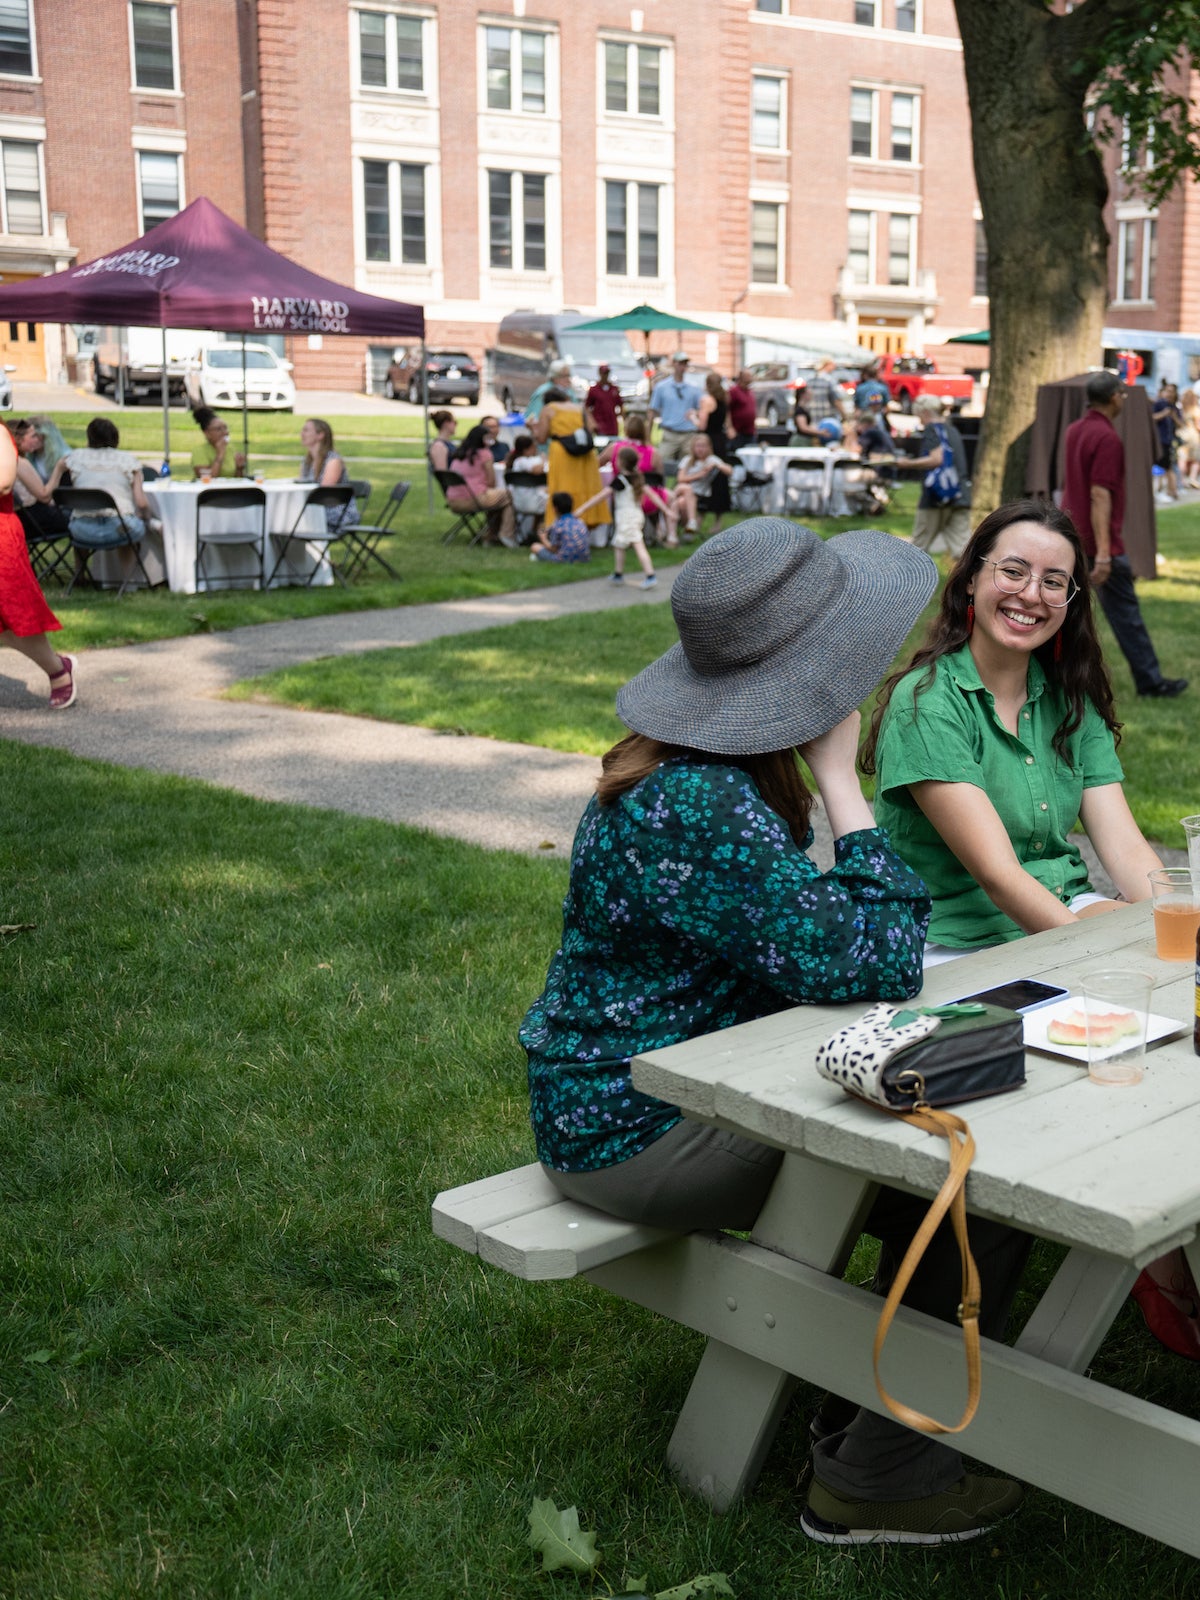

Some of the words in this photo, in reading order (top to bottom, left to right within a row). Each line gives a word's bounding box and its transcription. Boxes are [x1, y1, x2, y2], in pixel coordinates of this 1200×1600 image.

[251, 296, 350, 319] HARVARD
[254, 314, 286, 329] LAW
[289, 315, 351, 333] SCHOOL
